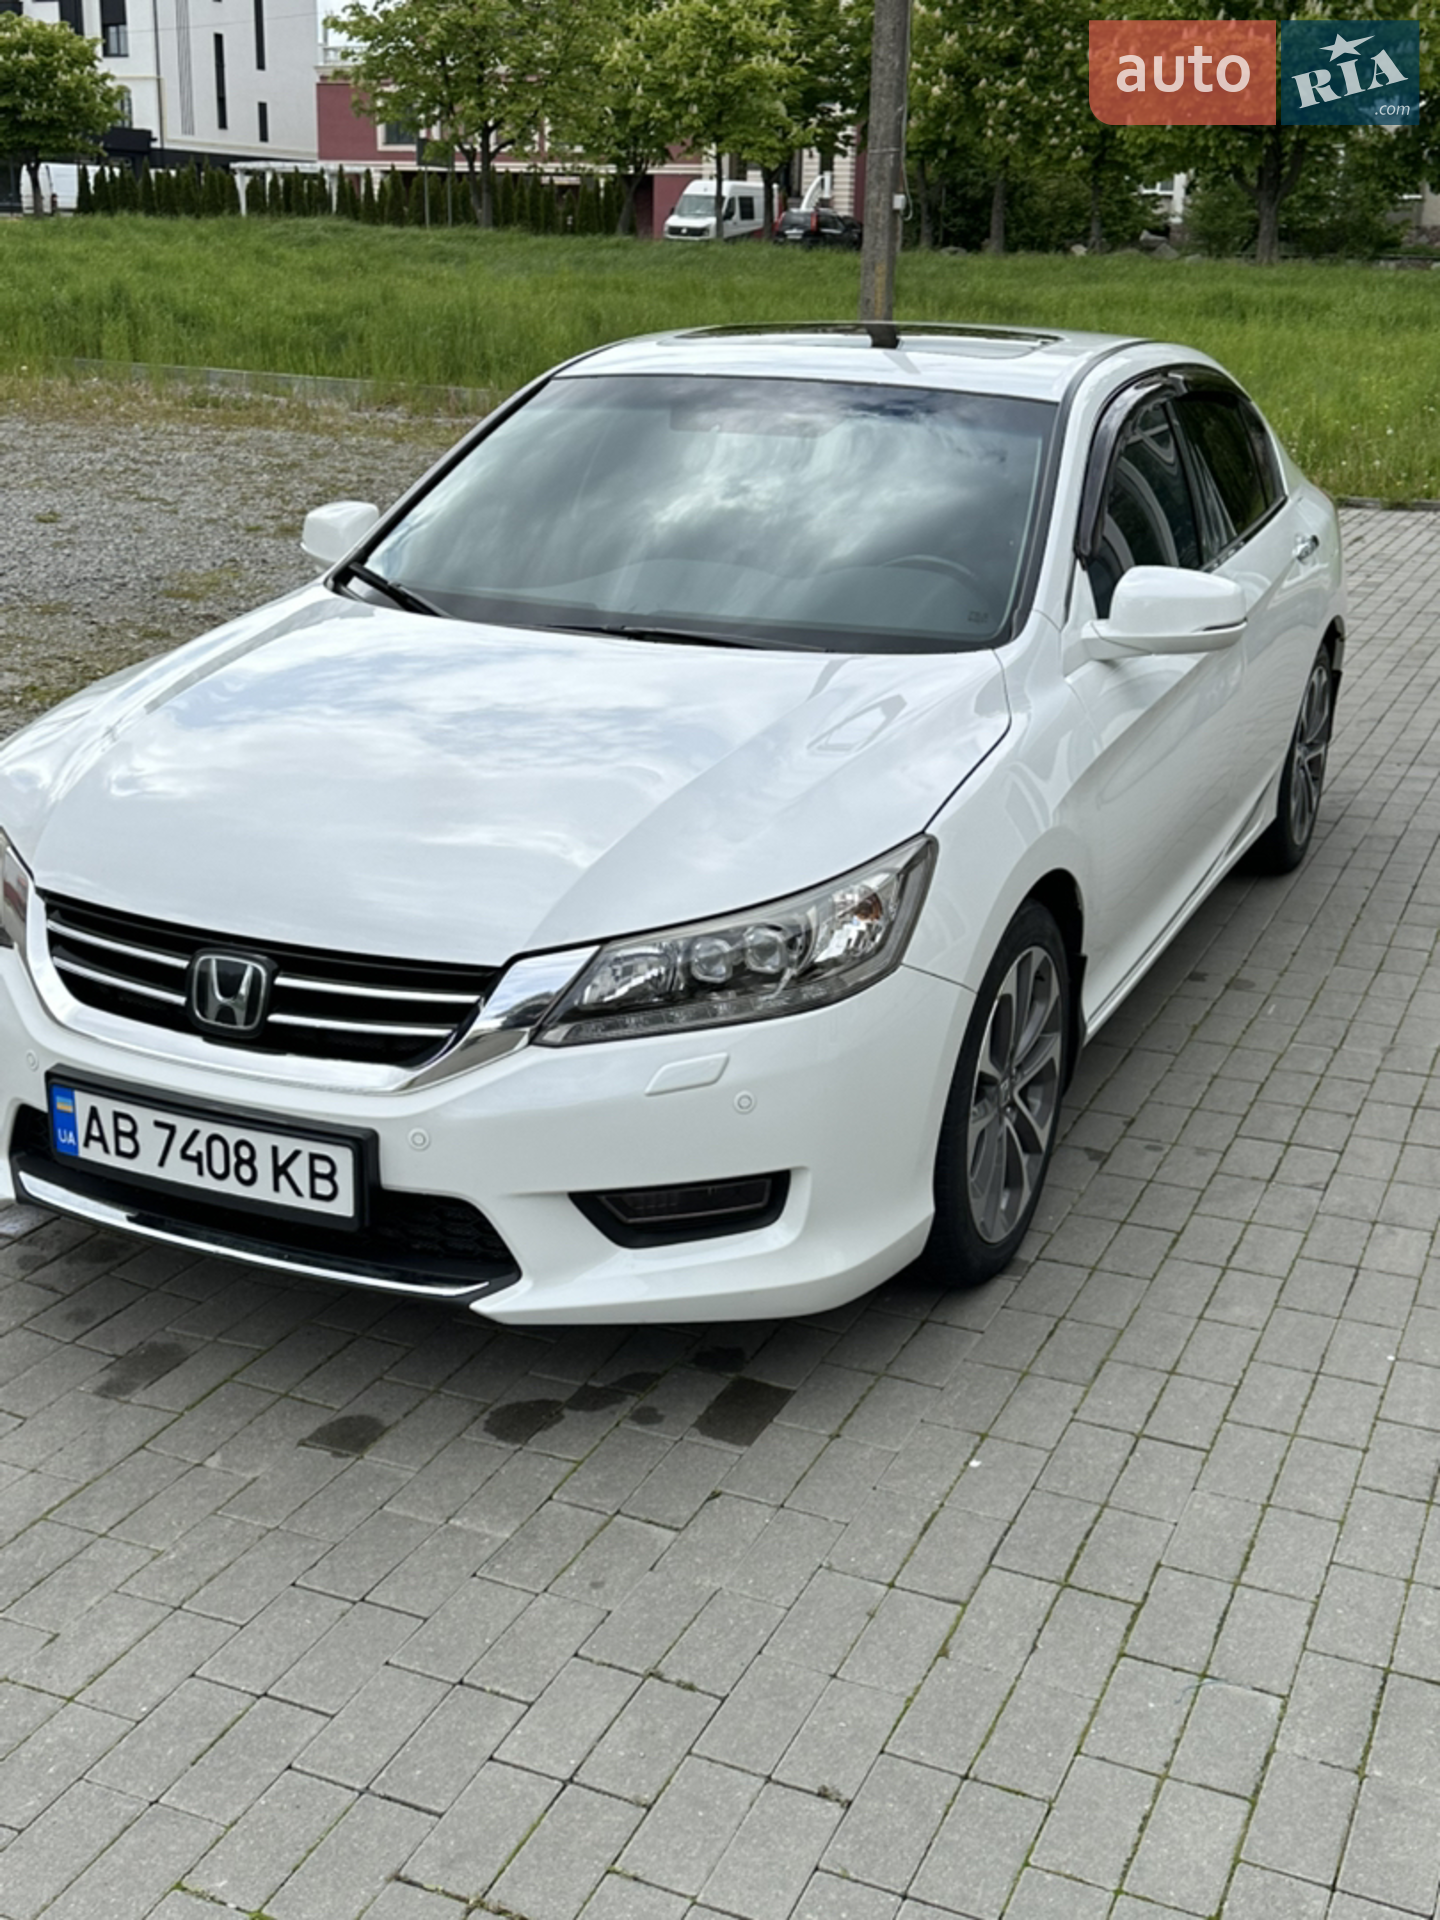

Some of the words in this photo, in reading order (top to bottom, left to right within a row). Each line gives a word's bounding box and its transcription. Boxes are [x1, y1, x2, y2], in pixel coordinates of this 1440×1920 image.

[57, 1128, 76, 1146] UA
[82, 1105, 140, 1160] AB
[153, 1119, 258, 1187] 7408
[271, 1145, 339, 1202] KB
